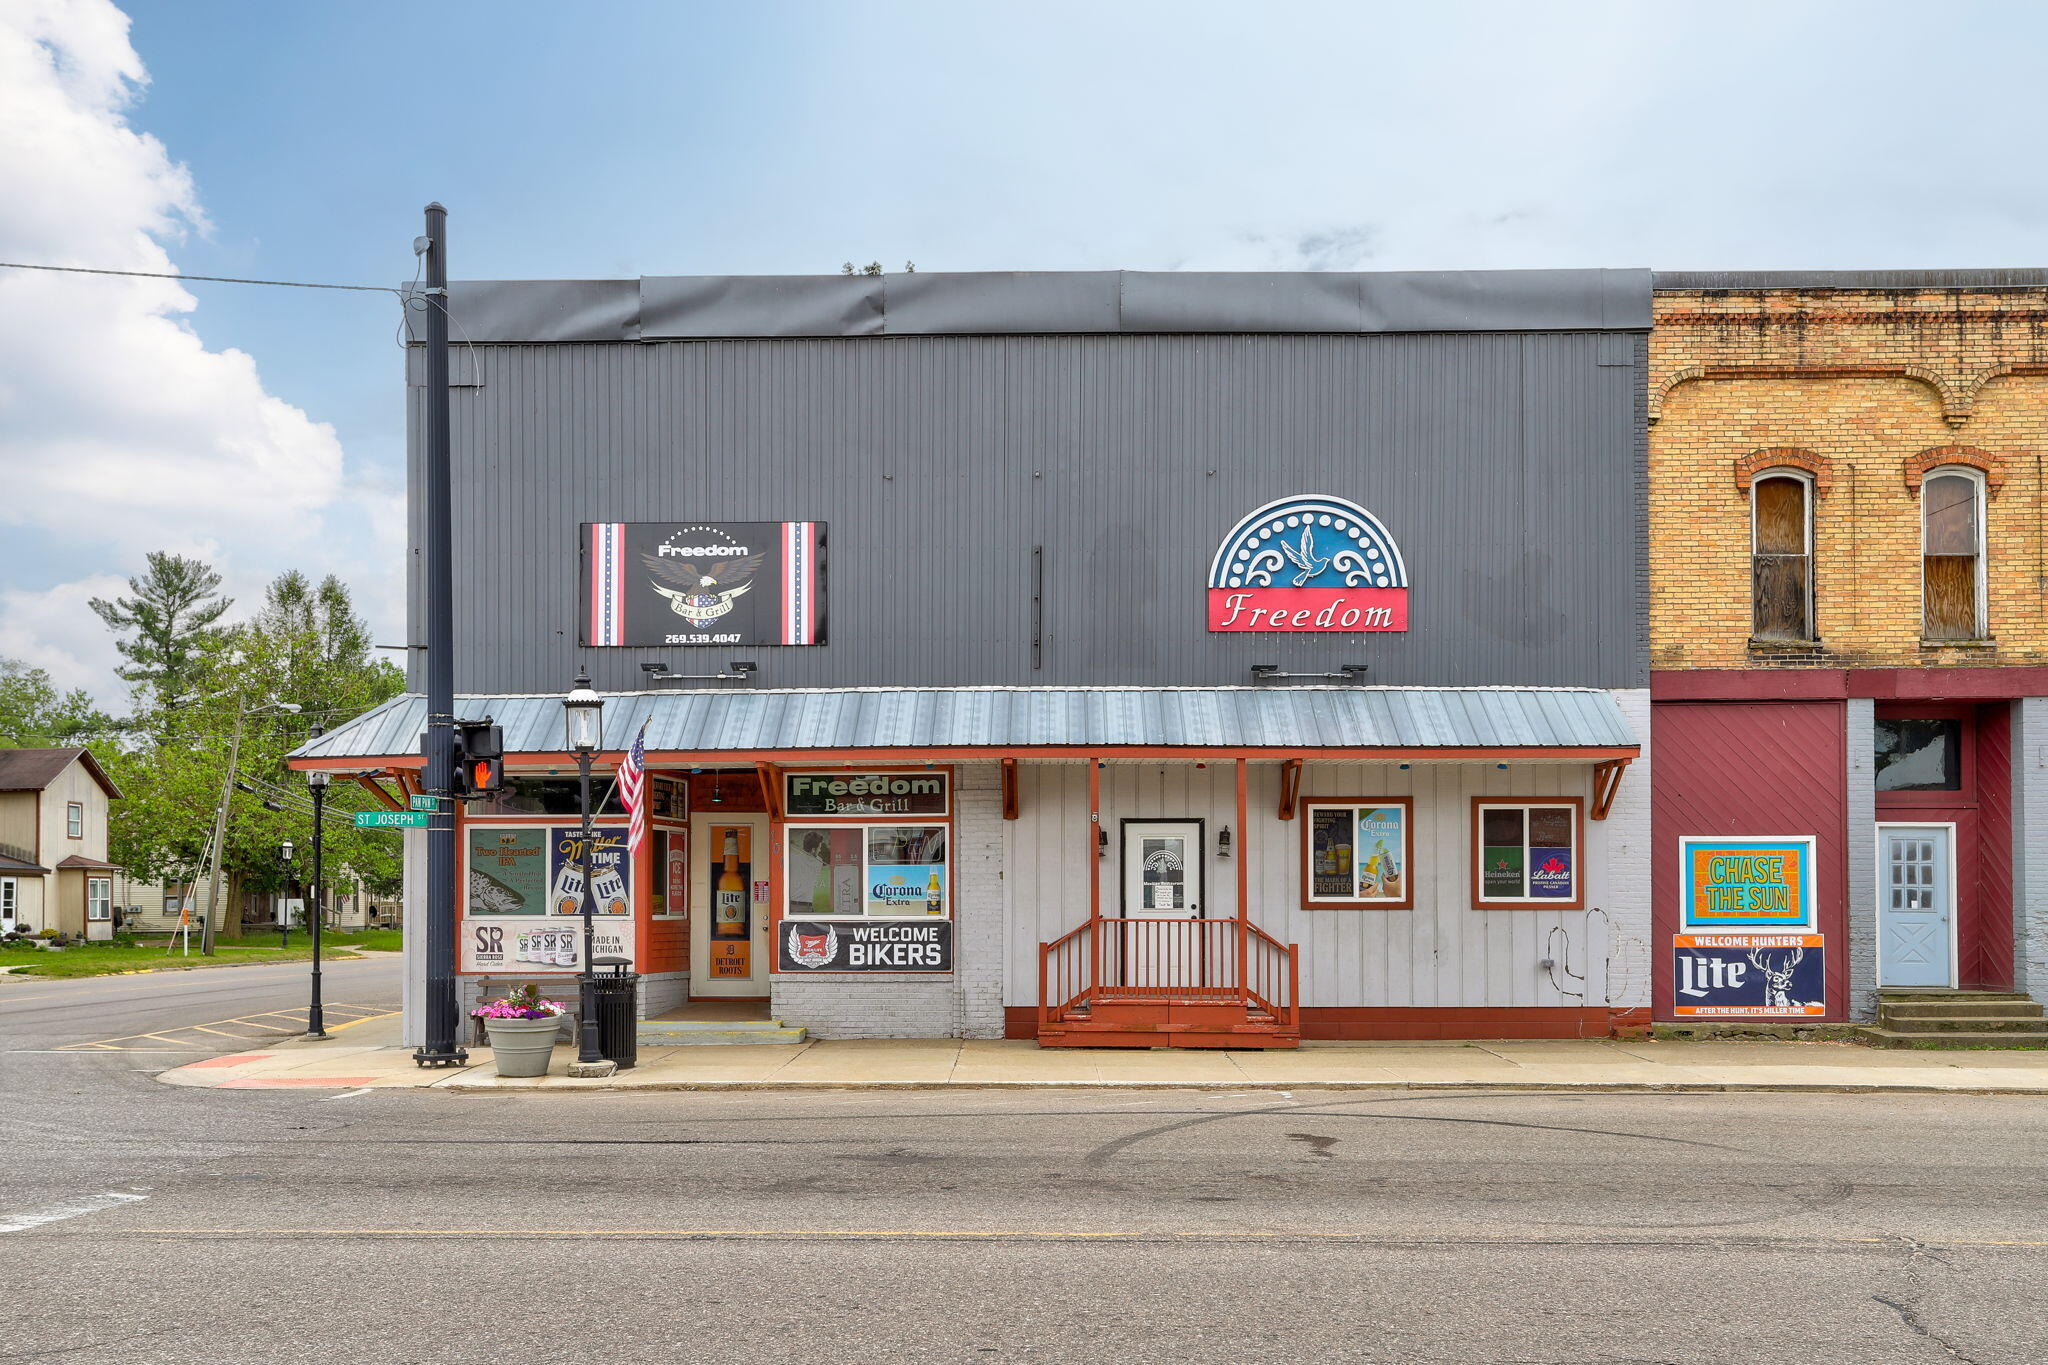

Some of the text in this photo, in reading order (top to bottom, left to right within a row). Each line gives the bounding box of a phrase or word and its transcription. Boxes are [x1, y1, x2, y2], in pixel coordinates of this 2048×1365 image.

[658, 544, 748, 556] Freedom
[674, 602, 731, 617] Bar & Grill
[1221, 593, 1394, 628] Freedom
[665, 633, 741, 644] 269.539.4047
[792, 776, 940, 796] Freedom
[824, 797, 910, 812] Bar & Grill
[358, 814, 370, 825] ST
[375, 814, 414, 825] JOSEPH
[1360, 820, 1399, 832] Corona
[476, 846, 541, 856] Two Hearted
[559, 836, 622, 861] Mller
[498, 857, 516, 866] IPA
[591, 852, 620, 864] TIME
[1485, 870, 1520, 878] Heineken
[1531, 870, 1570, 880] Labatt
[1710, 856, 1783, 884] CHASE
[596, 878, 622, 899] Lite
[872, 884, 922, 901] Corona
[1314, 883, 1352, 892] FIGHTER
[722, 892, 740, 905] Lite
[842, 878, 851, 912] LTRA
[1706, 886, 1788, 911] THE SUN
[886, 898, 910, 906] Extra
[476, 926, 504, 952] SR
[561, 934, 572, 948] SR
[612, 936, 620, 944] IN
[853, 928, 938, 942] WELCOME
[1694, 936, 1804, 946] WELCOME HUNTERS
[592, 945, 624, 953] ICHIGAN
[850, 944, 941, 965] BIKERS
[716, 958, 745, 966] DETROIT
[1678, 956, 1746, 998] Lite
